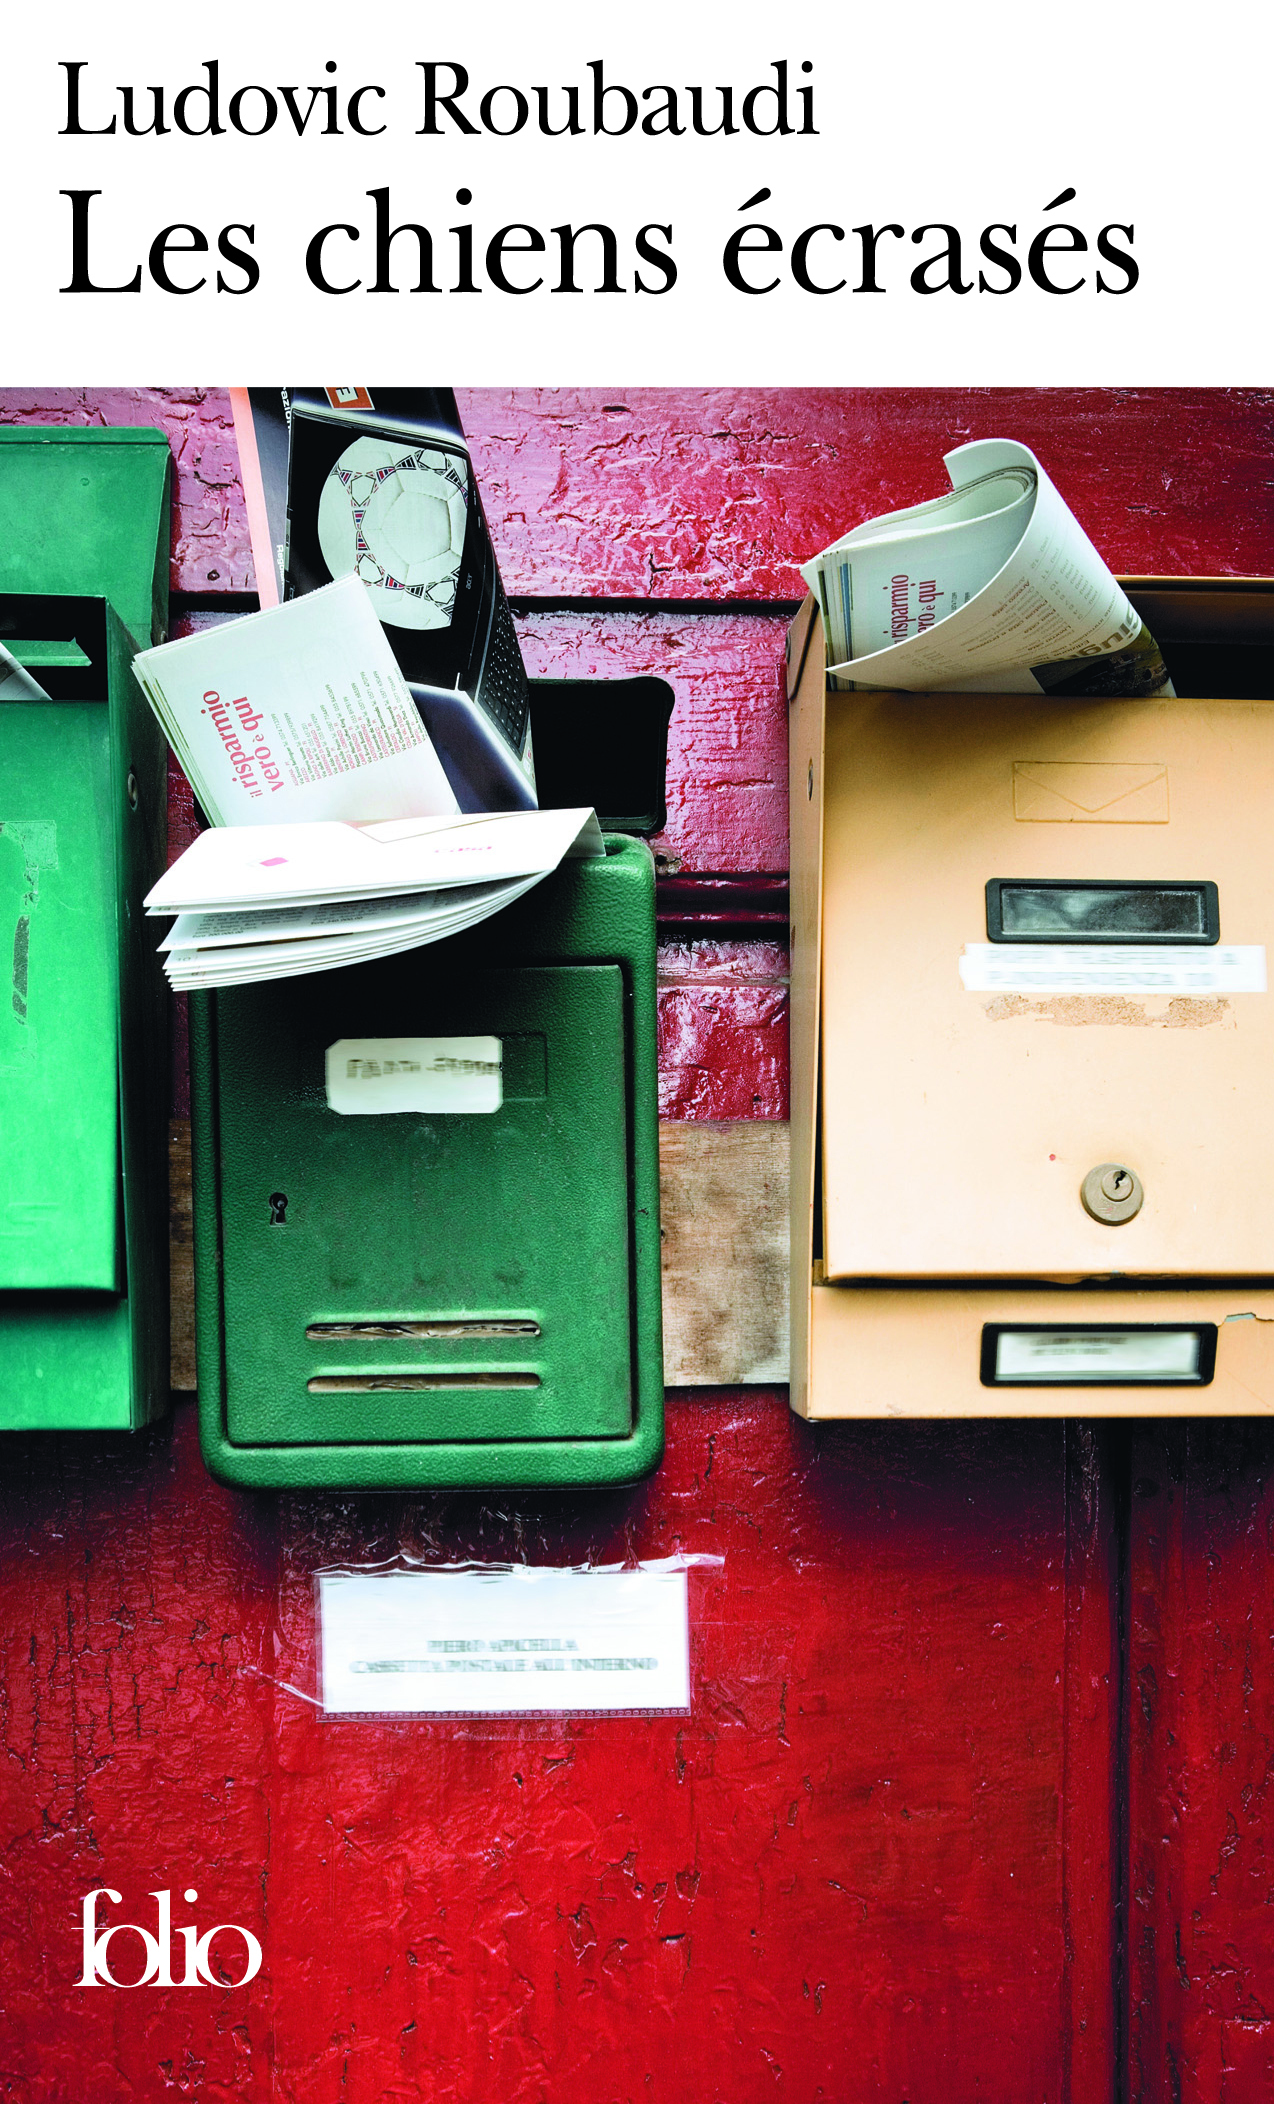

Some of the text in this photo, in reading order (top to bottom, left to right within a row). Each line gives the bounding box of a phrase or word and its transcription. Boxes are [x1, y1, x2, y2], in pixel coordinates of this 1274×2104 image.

[911, 581, 943, 605] qui
[1008, 581, 1031, 604] Arezzo
[883, 575, 916, 638] risparmio
[1025, 600, 1048, 620] Pistoia
[226, 696, 264, 731] qui
[339, 718, 347, 728] King
[374, 706, 386, 729] Quasimodo
[383, 729, 393, 748] Salvatore
[395, 728, 404, 743] Claudio
[404, 720, 415, 739] Armando
[201, 691, 263, 798] il risparmio
[324, 747, 332, 758] Moro
[362, 744, 370, 756] Bruno
[371, 734, 381, 752] Leonardo
[286, 746, 298, 766] Berlinguer
[339, 750, 347, 764] Achille
[353, 754, 362, 767] Piazza
[255, 746, 284, 792] vero
[300, 767, 310, 783] AREZZO
